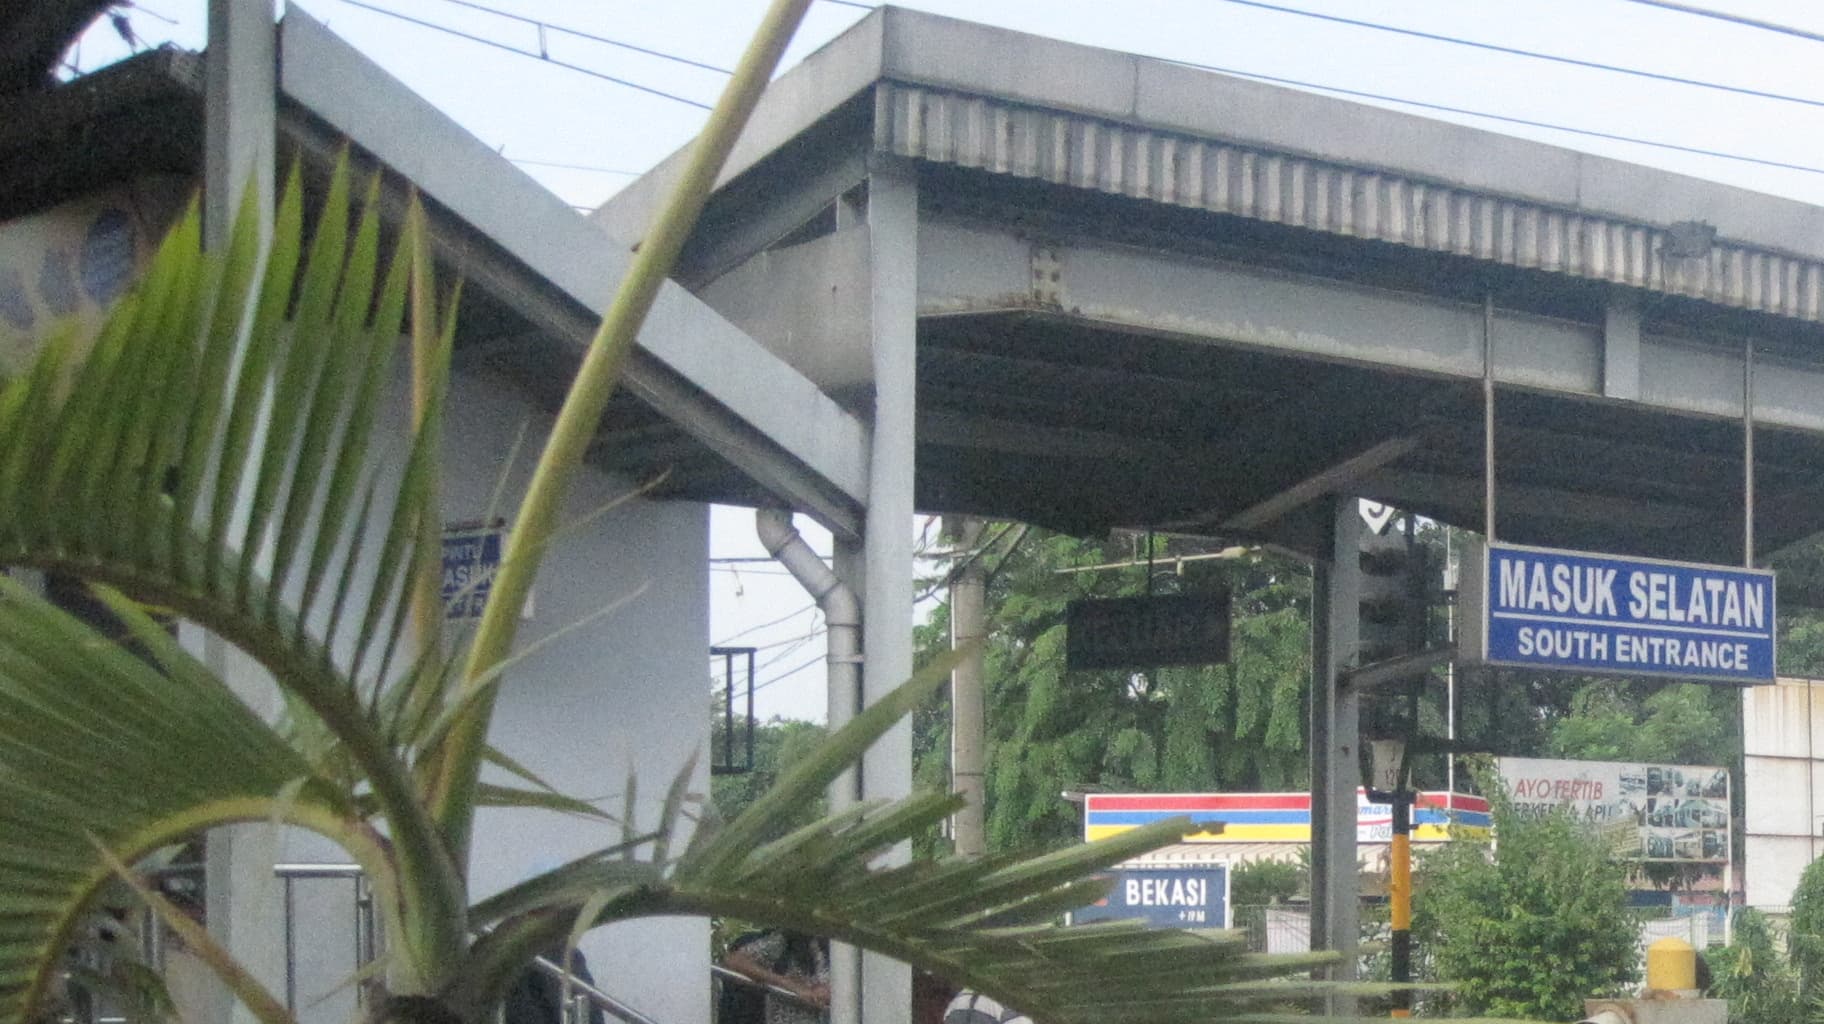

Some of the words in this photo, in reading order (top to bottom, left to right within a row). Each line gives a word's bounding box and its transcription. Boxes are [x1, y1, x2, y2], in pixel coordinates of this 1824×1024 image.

[1500, 559, 1617, 616] MASUK
[1629, 571, 1763, 628] SELATAN
[1518, 626, 1607, 661] SOUTH
[1615, 635, 1748, 670] ENTRANCE
[1126, 879, 1207, 906] BEKASI
